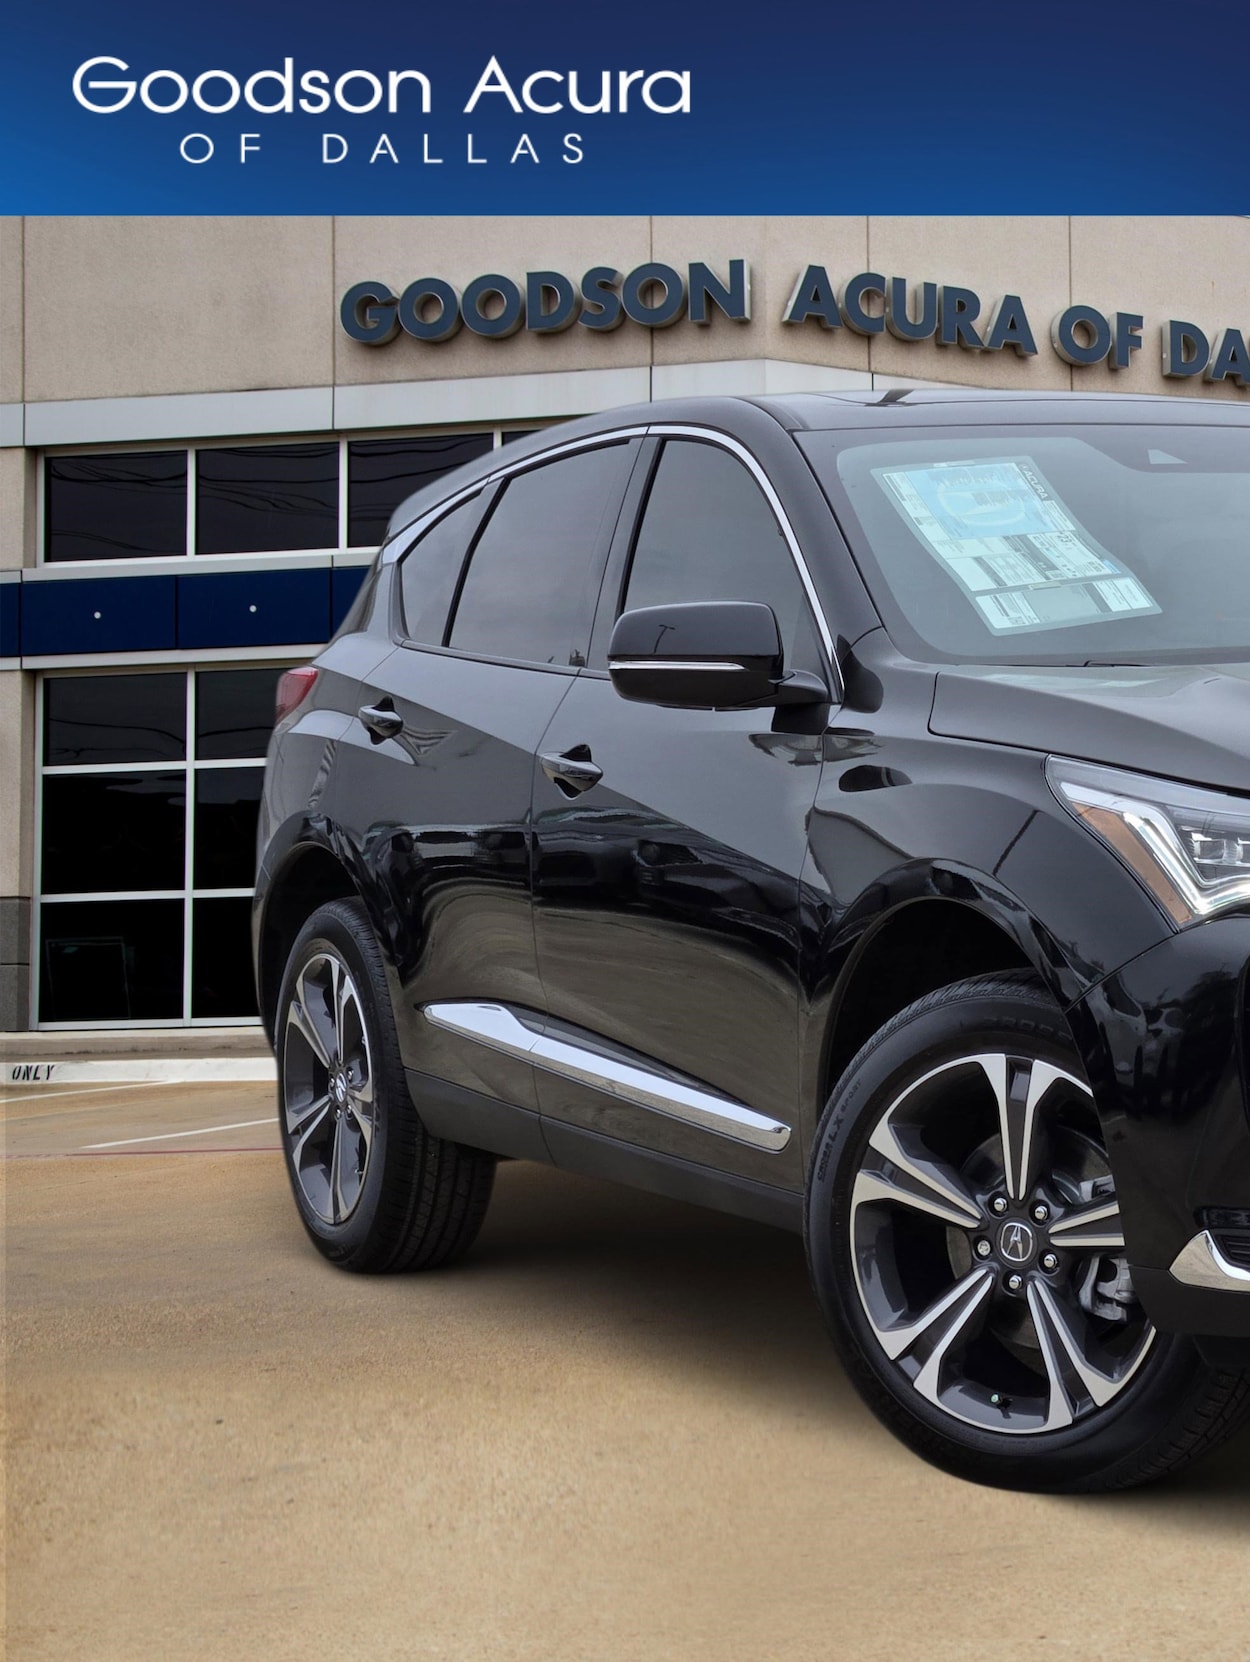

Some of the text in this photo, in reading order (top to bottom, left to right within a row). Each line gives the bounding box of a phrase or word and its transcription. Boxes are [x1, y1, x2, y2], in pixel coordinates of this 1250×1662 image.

[340, 259, 751, 346] GOODSON
[783, 265, 1038, 356] ACURA
[1052, 305, 1144, 370] OF
[1023, 470, 1048, 500] ACURA
[12, 1064, 55, 1080] ONLY
